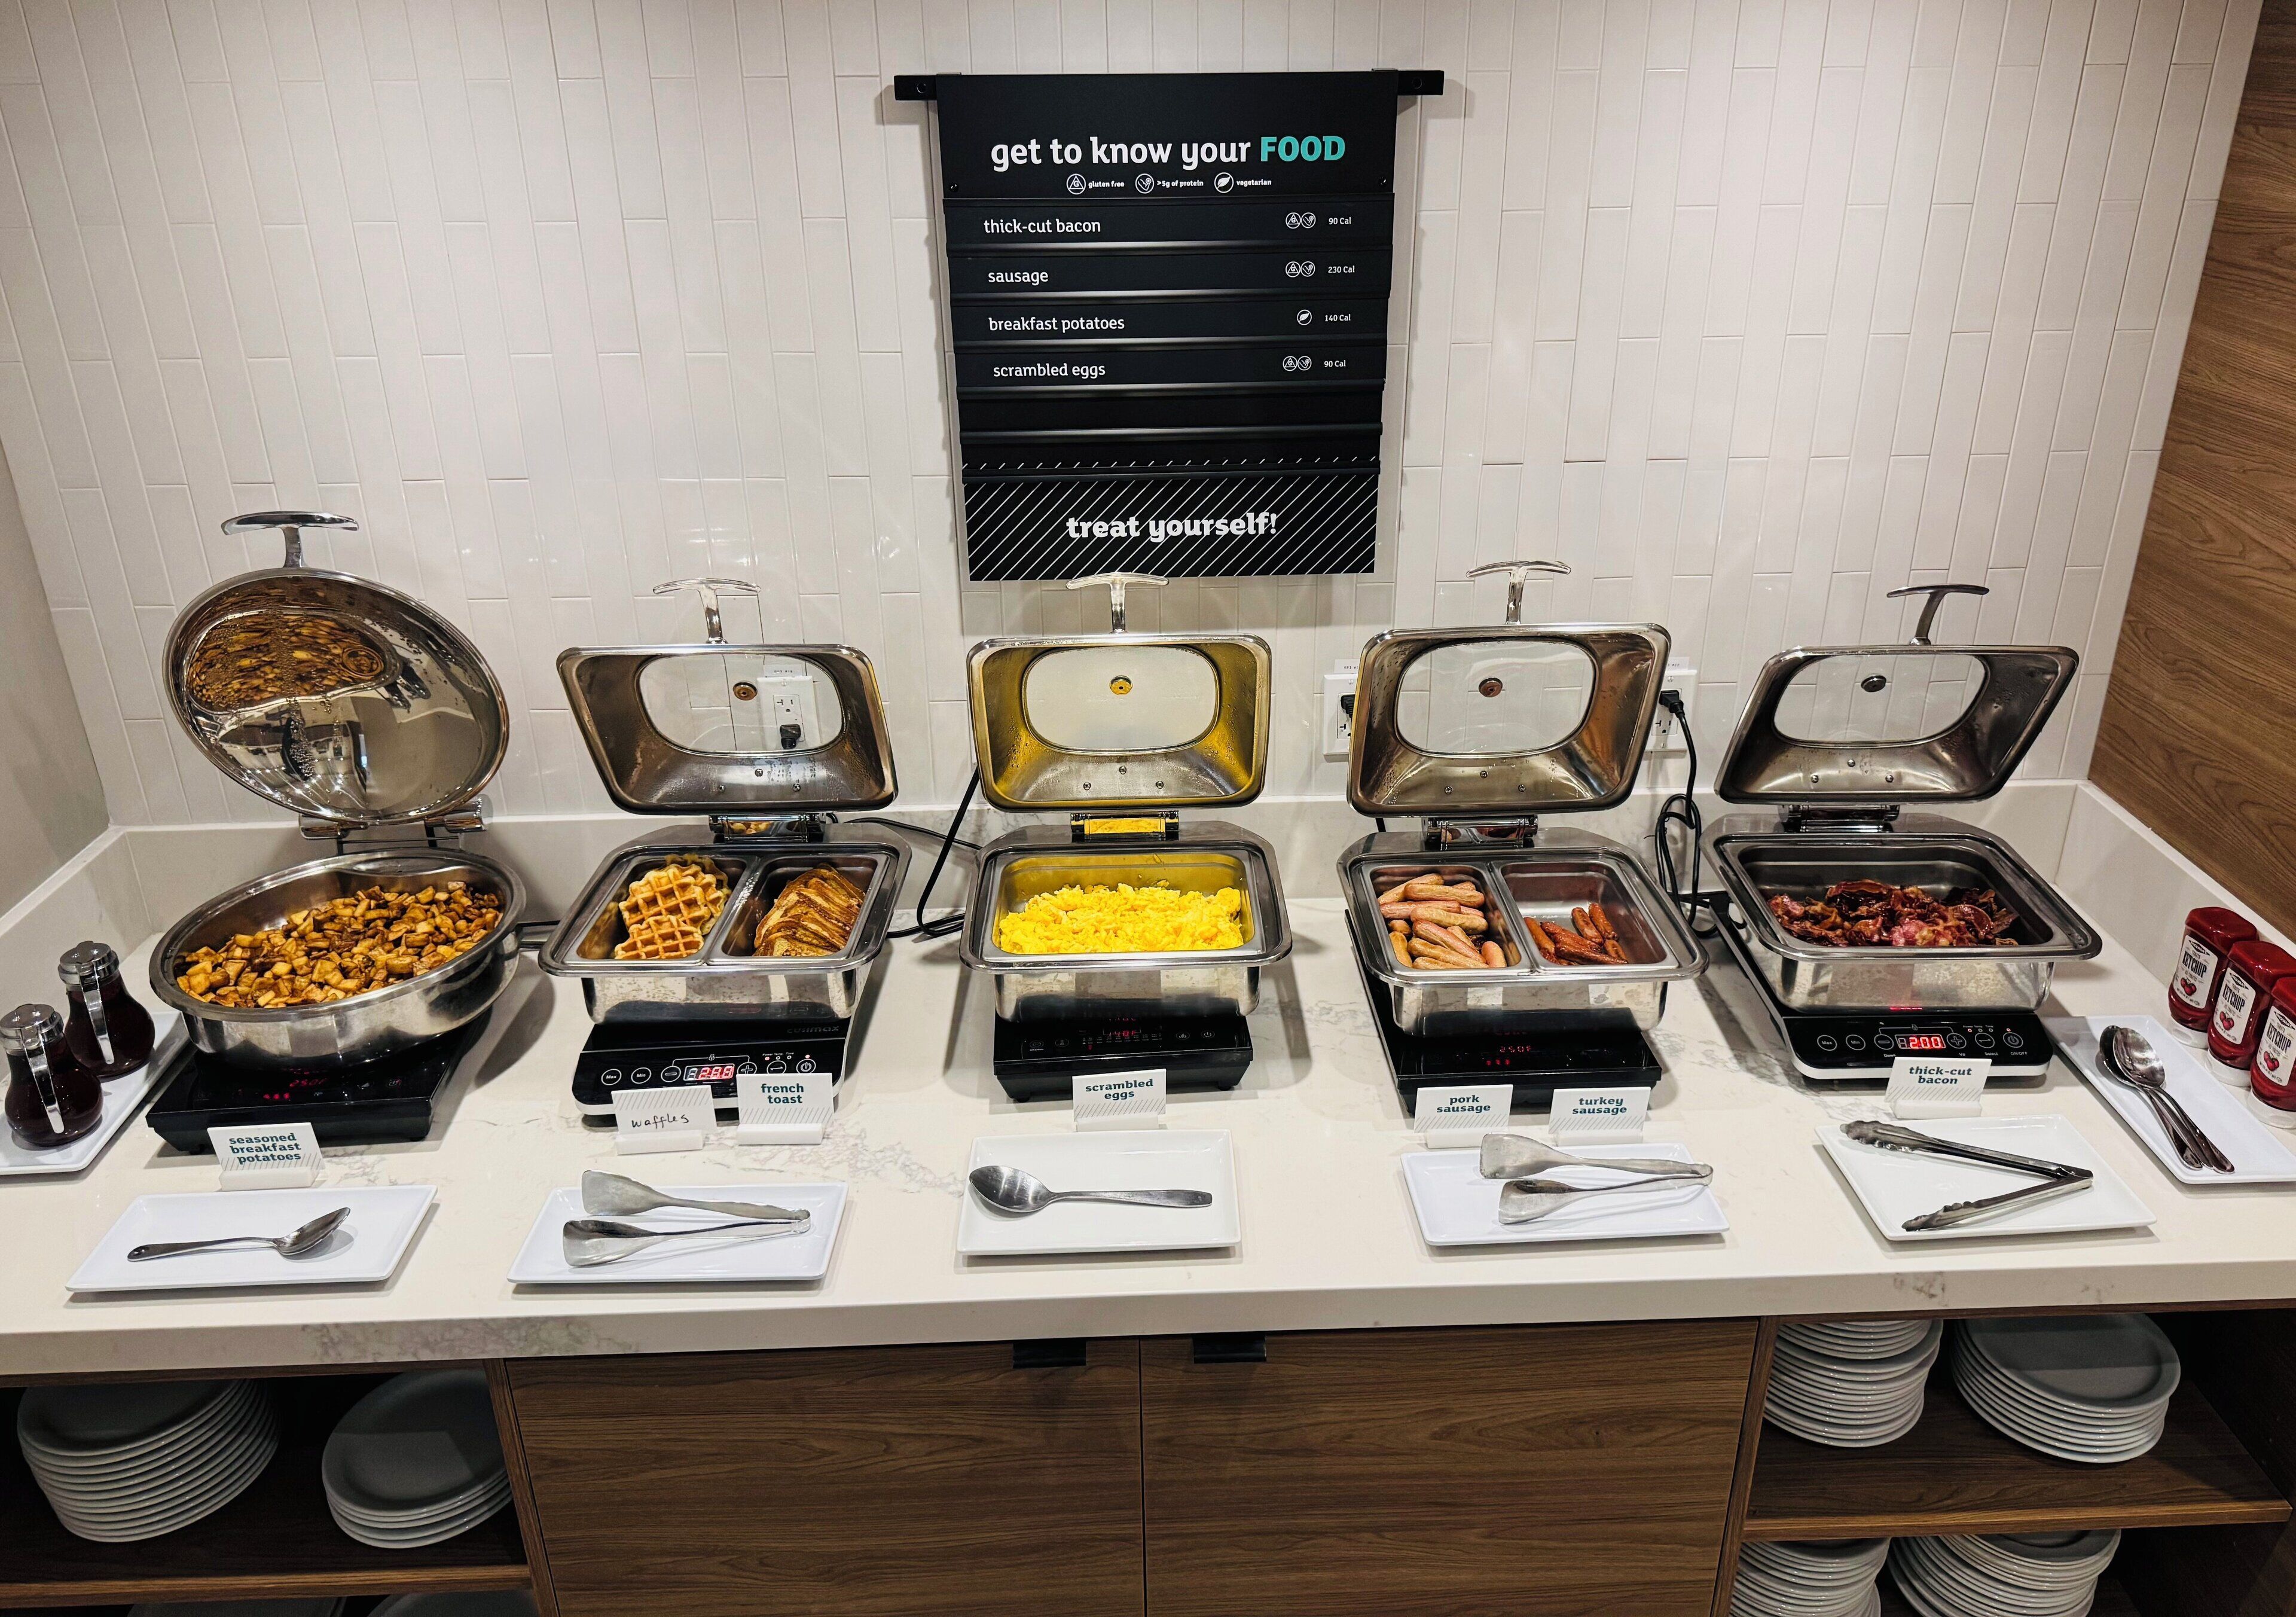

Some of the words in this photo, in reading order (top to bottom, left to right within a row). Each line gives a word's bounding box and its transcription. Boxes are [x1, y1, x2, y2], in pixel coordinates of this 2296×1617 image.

[991, 138, 1042, 172] get
[1050, 138, 1082, 164] to
[1091, 137, 1171, 164] know
[1181, 141, 1251, 171] your
[1260, 136, 1345, 162] FOOD
[1088, 181, 1109, 190] gluten
[1156, 180, 1170, 189] >5g
[1180, 179, 1204, 189] protein
[1236, 179, 1272, 188] vegetarian
[983, 218, 1052, 234] thick-cut
[1055, 218, 1101, 233] bacon
[1329, 217, 1338, 225] 90
[1339, 216, 1351, 225] Cal
[1343, 265, 1355, 273] Cal
[988, 271, 1049, 286] sausage
[1339, 313, 1351, 322] Cal
[988, 316, 1058, 331] breakfast
[1061, 317, 1125, 334] potatoes
[1334, 359, 1346, 368] Cal
[993, 362, 1068, 378] scrambled
[1071, 365, 1106, 379] eggs
[1066, 515, 1140, 539] treat
[1149, 512, 1278, 543] yourself!
[2182, 950, 2207, 978] KETCHUP
[2222, 984, 2245, 1012] KETCHUP
[1909, 1036, 1943, 1049] 200
[2267, 1023, 2291, 1054] KETCHUP
[1909, 1066, 1973, 1076] thick-cut
[1085, 1078, 1154, 1093] scrambled
[1918, 1075, 1959, 1085] bacon
[761, 1083, 804, 1094] french
[767, 1094, 803, 1105] toast
[1104, 1091, 1135, 1101] eggs
[1449, 1094, 1480, 1105] pork
[1578, 1096, 1624, 1108] turkey
[1436, 1103, 1491, 1113] sausage
[1572, 1105, 1628, 1115] sausage
[631, 1113, 690, 1129] waffles
[229, 1133, 297, 1144] seasoned
[230, 1142, 301, 1154] breakfast
[237, 1152, 301, 1165] potatoes
